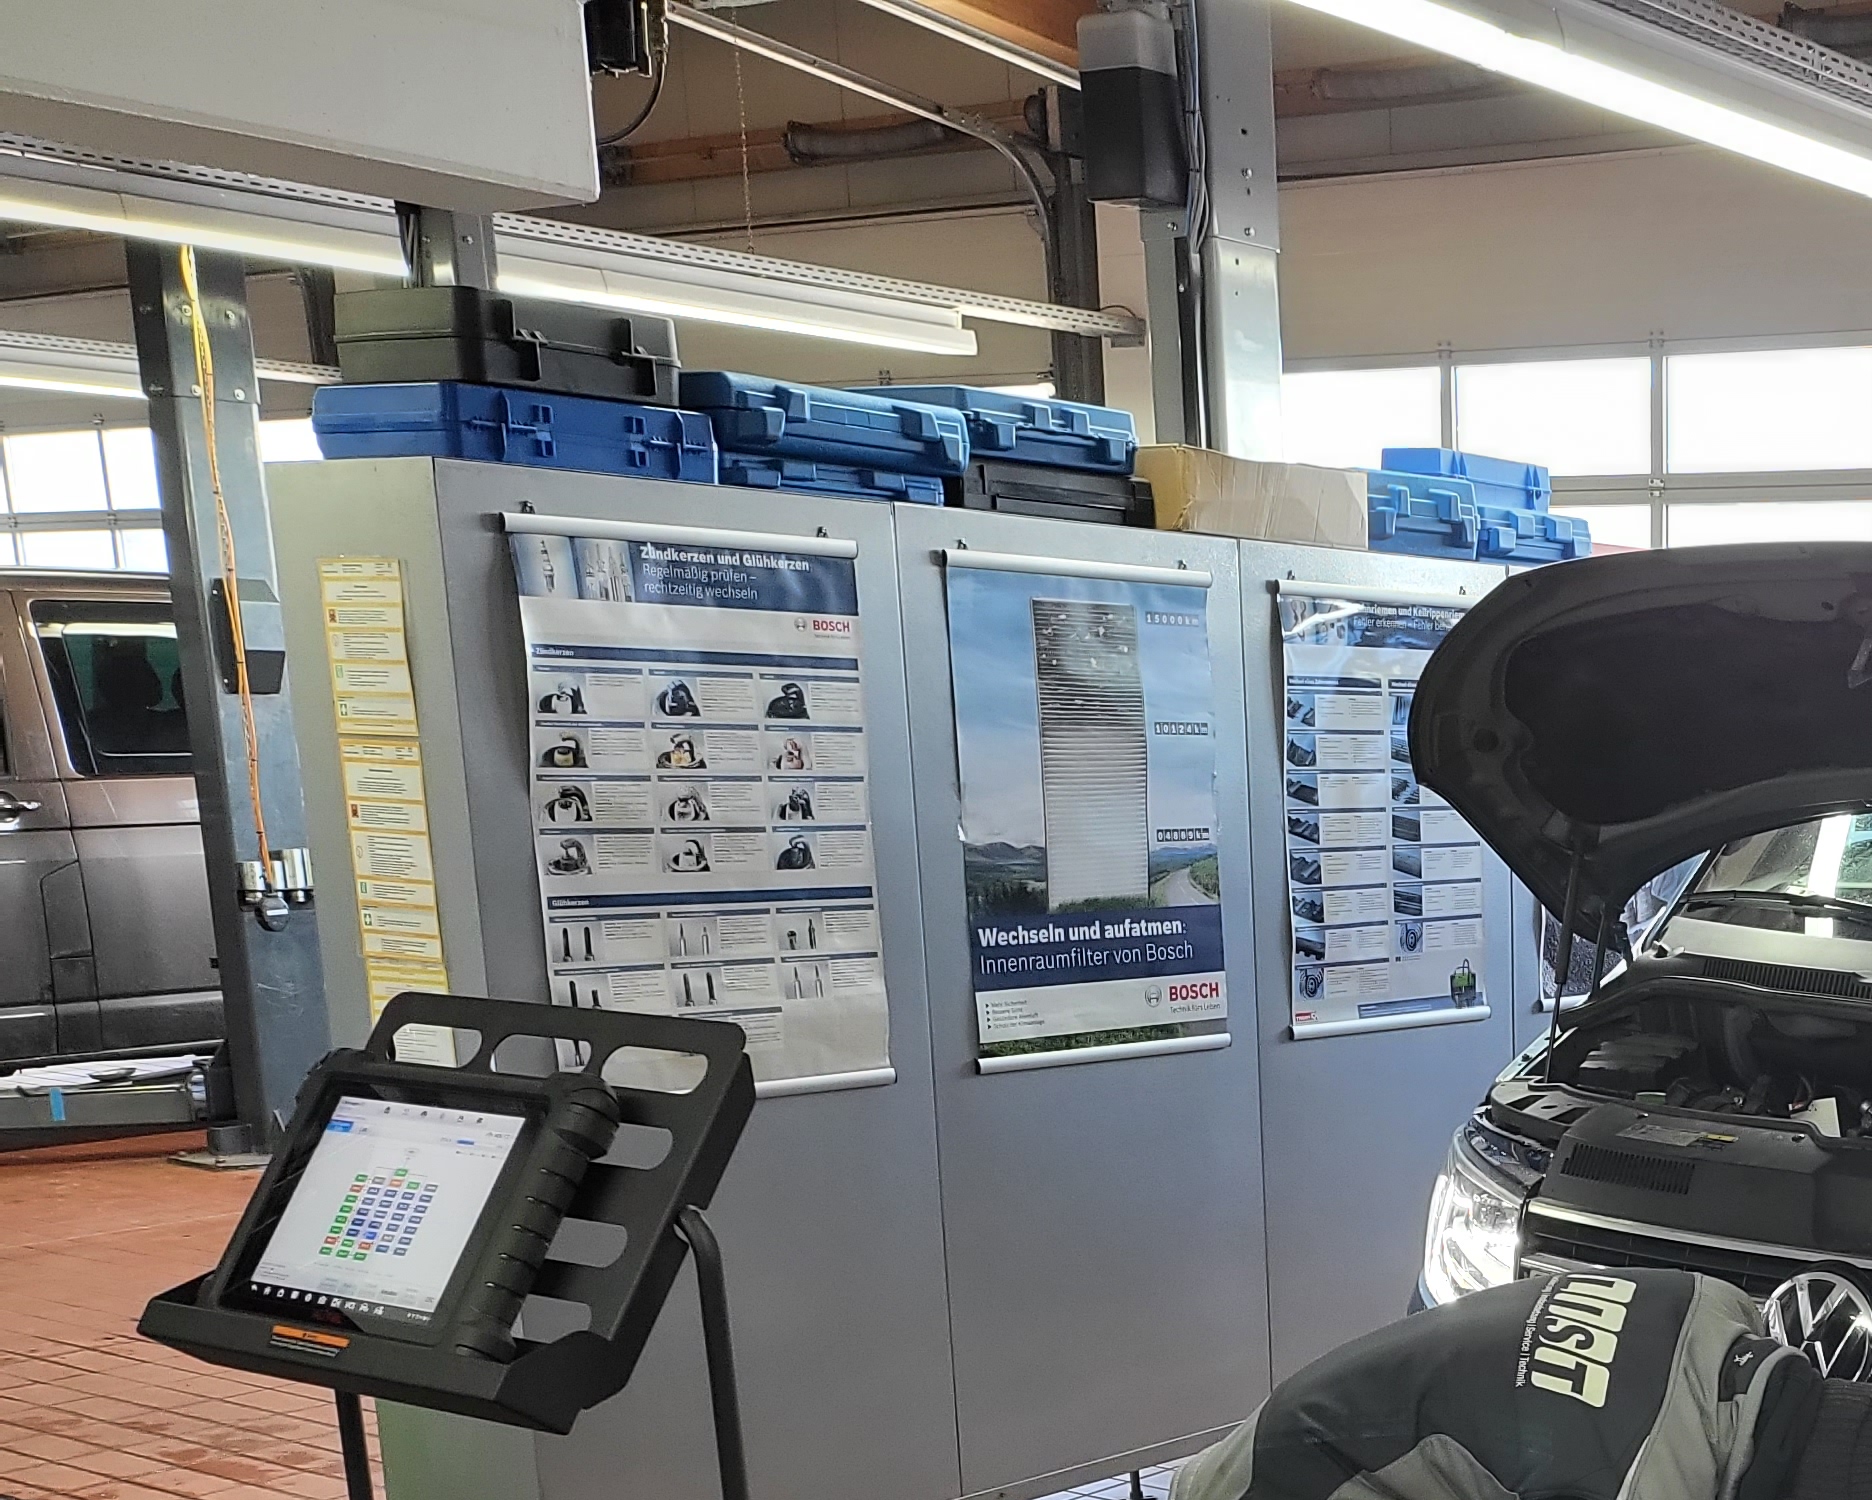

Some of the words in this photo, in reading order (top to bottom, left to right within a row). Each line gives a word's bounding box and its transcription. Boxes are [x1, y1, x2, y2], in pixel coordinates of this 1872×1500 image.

[640, 545, 713, 564] Zündkerzen
[717, 553, 740, 566] und
[743, 554, 810, 571] Glühkerzen
[643, 563, 708, 581] Regelmäßig
[711, 569, 747, 584] prüfen
[644, 582, 704, 599] rechtzeitig
[705, 585, 758, 600] wechseln
[812, 619, 850, 633] BOSCH
[978, 923, 1065, 947] Wechseln
[1068, 921, 1101, 941] und
[1104, 918, 1187, 940] aufatmen:
[980, 948, 1110, 975] Innenraumfilter
[1113, 949, 1141, 964] von
[1146, 940, 1194, 961] Bosch
[1169, 981, 1219, 1002] BOSCH
[1521, 1326, 1536, 1352] Service
[1515, 1357, 1530, 1388] Technik
